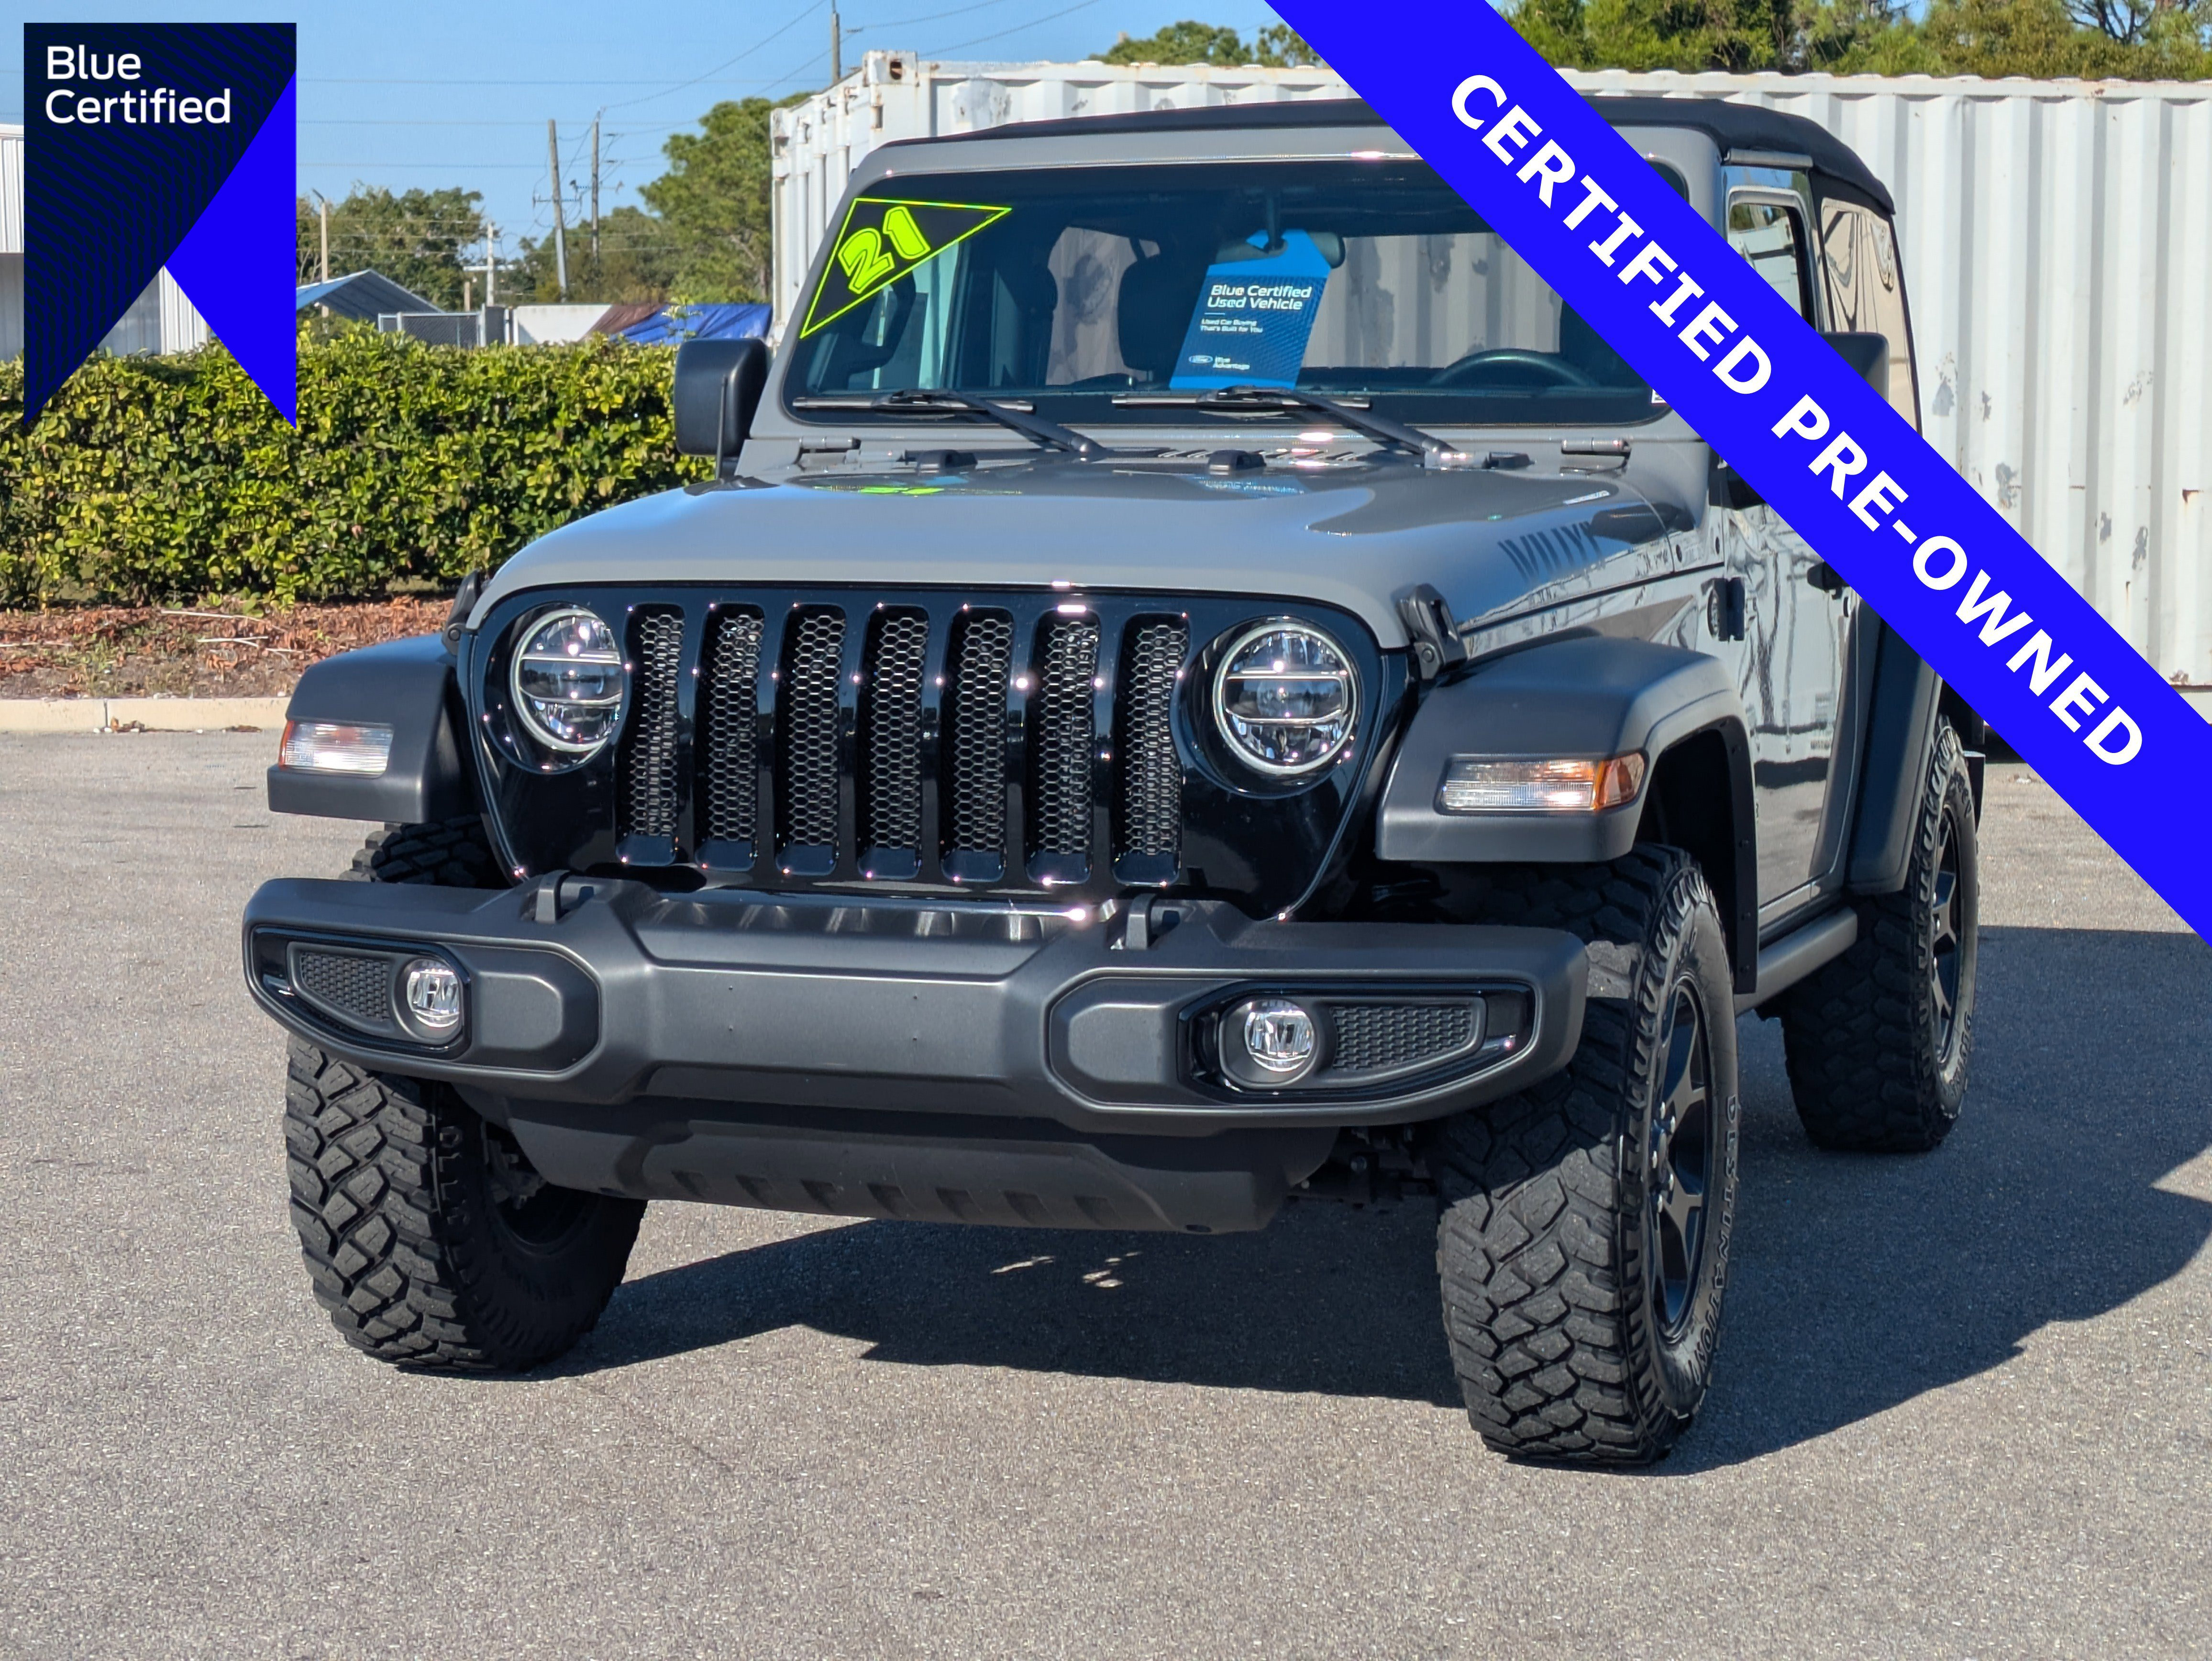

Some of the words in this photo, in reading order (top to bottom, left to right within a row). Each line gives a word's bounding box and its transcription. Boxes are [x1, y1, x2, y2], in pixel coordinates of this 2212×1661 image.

[838, 206, 930, 294] 21
[1210, 284, 1245, 296] Blue
[1247, 285, 1313, 299] Certified
[1207, 296, 1247, 308] Used
[1250, 297, 1303, 310] Vehicle
